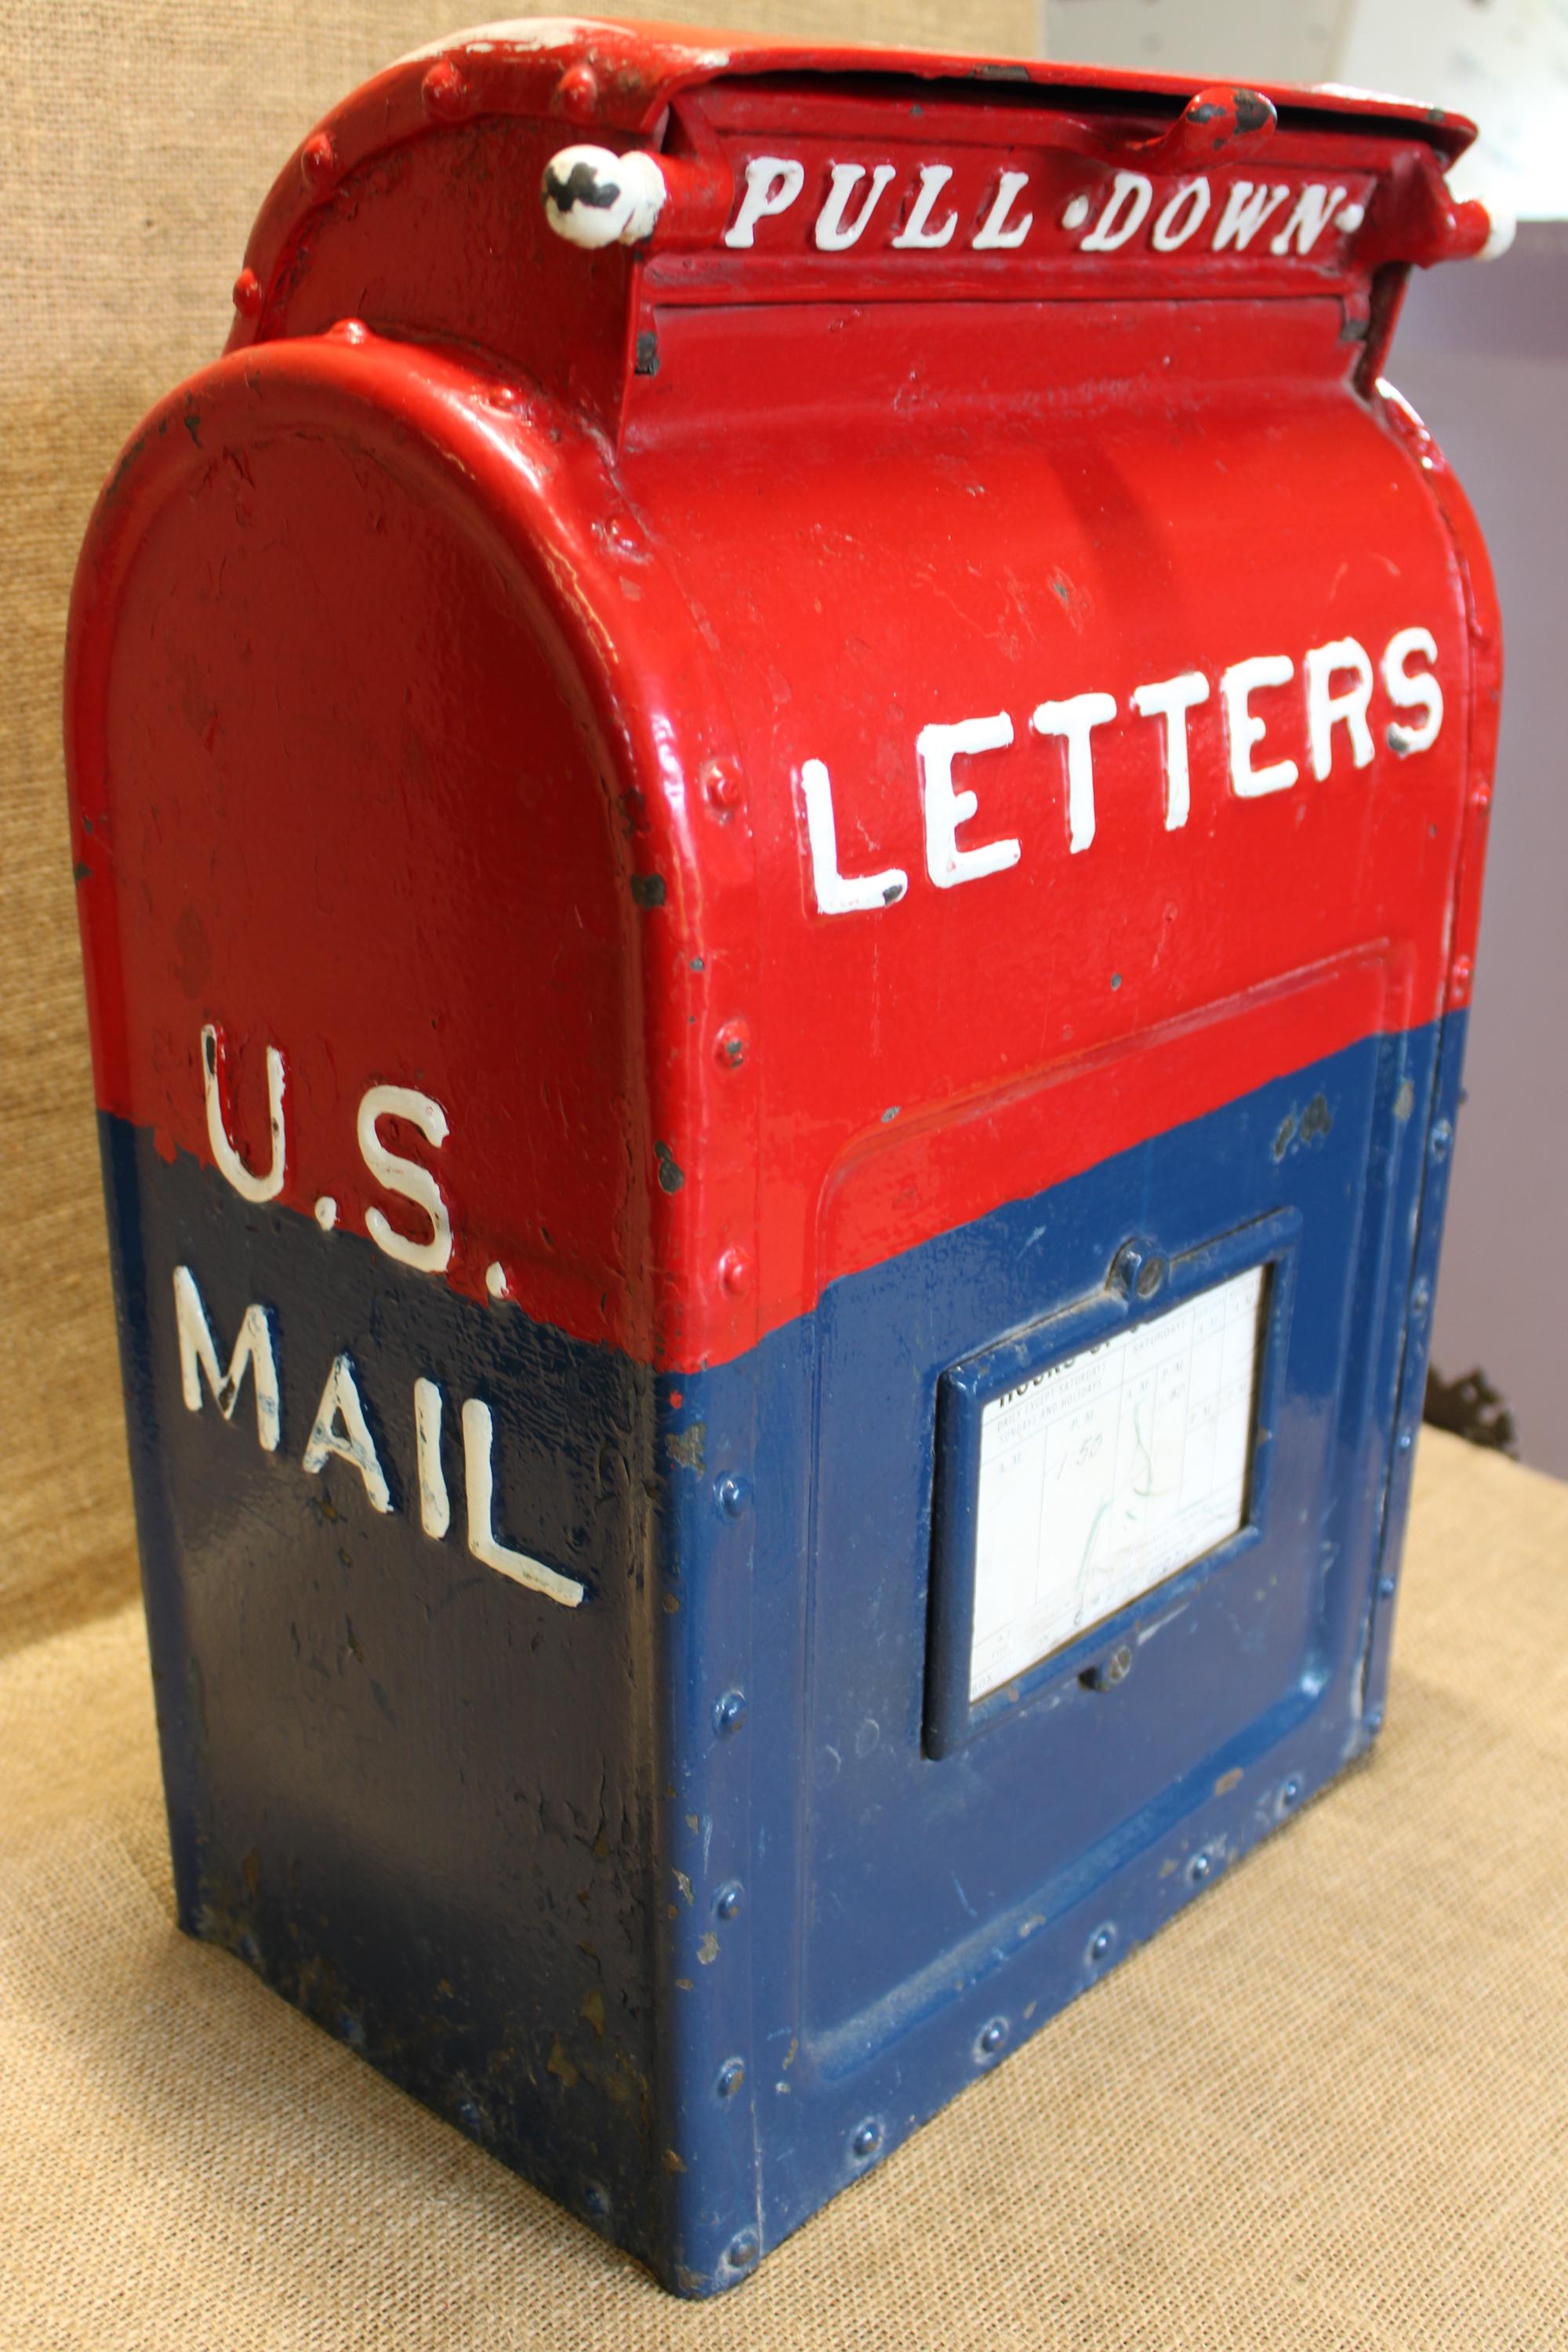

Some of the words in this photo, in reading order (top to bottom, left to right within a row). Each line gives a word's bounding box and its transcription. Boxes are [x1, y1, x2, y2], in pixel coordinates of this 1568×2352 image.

[724, 157, 1033, 252] PULL
[800, 627, 1444, 915] LETTERS
[201, 1023, 510, 1299] U.S.
[172, 1265, 585, 1608] MAIL
